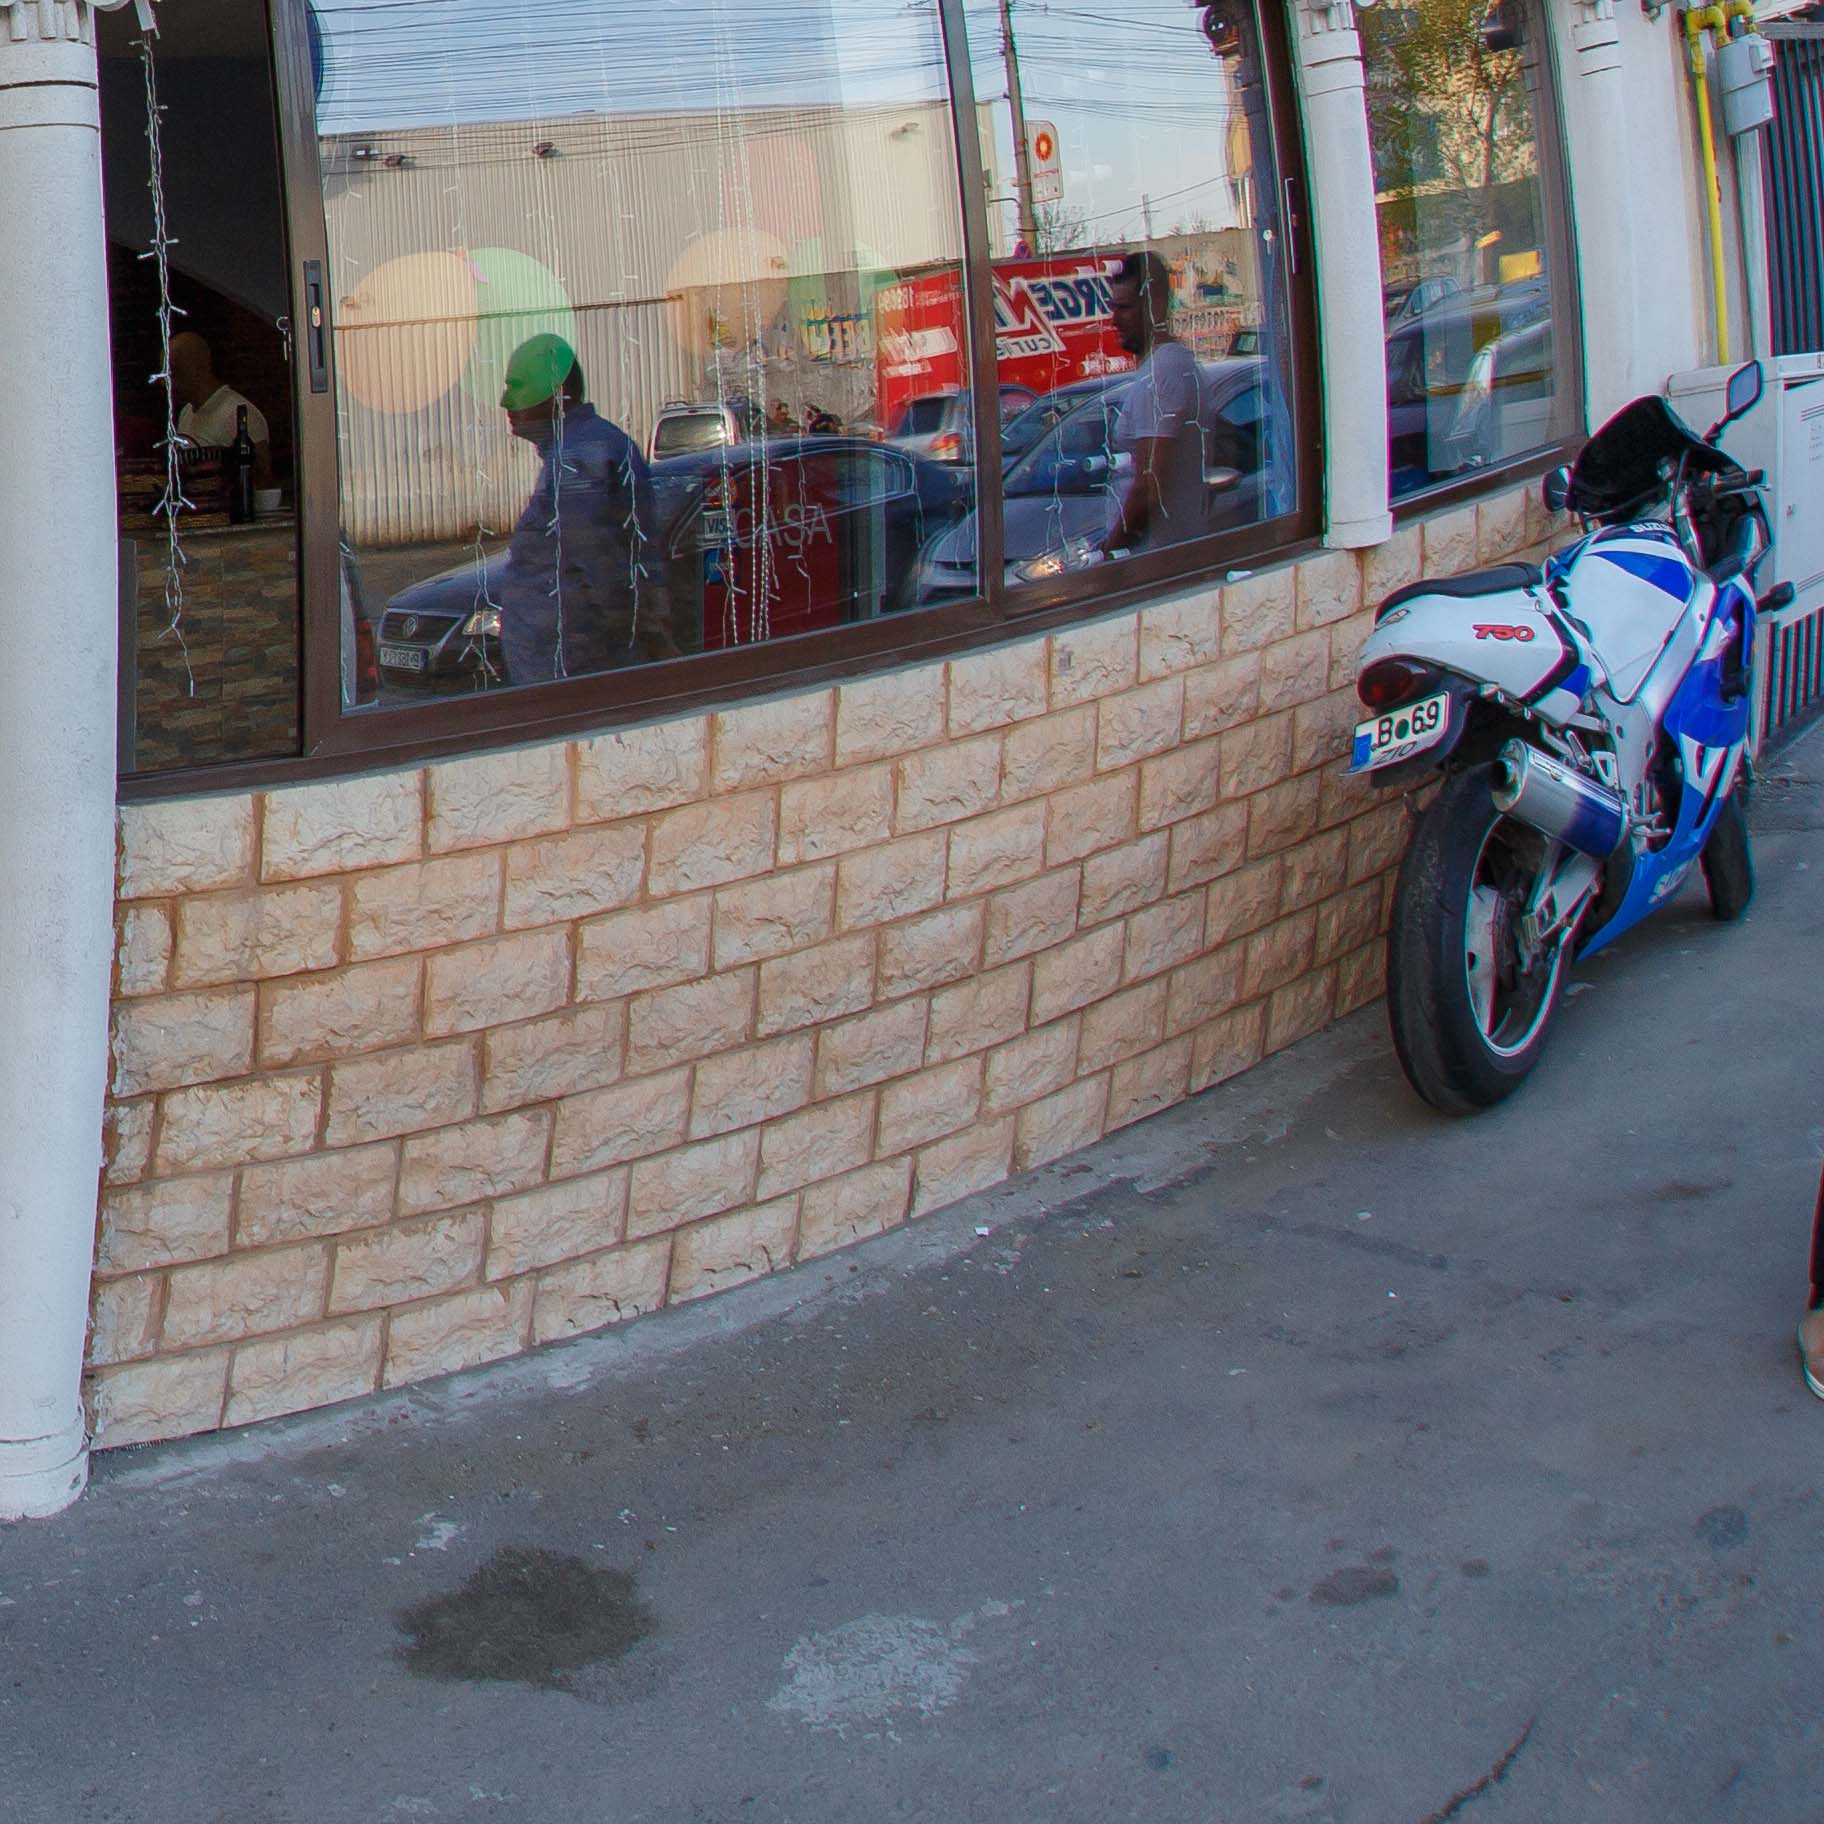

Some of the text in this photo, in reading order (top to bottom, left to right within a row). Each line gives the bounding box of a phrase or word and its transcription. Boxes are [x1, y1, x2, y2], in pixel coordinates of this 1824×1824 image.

[1472, 624, 1535, 642] 750
[1377, 700, 1440, 748] B 69
